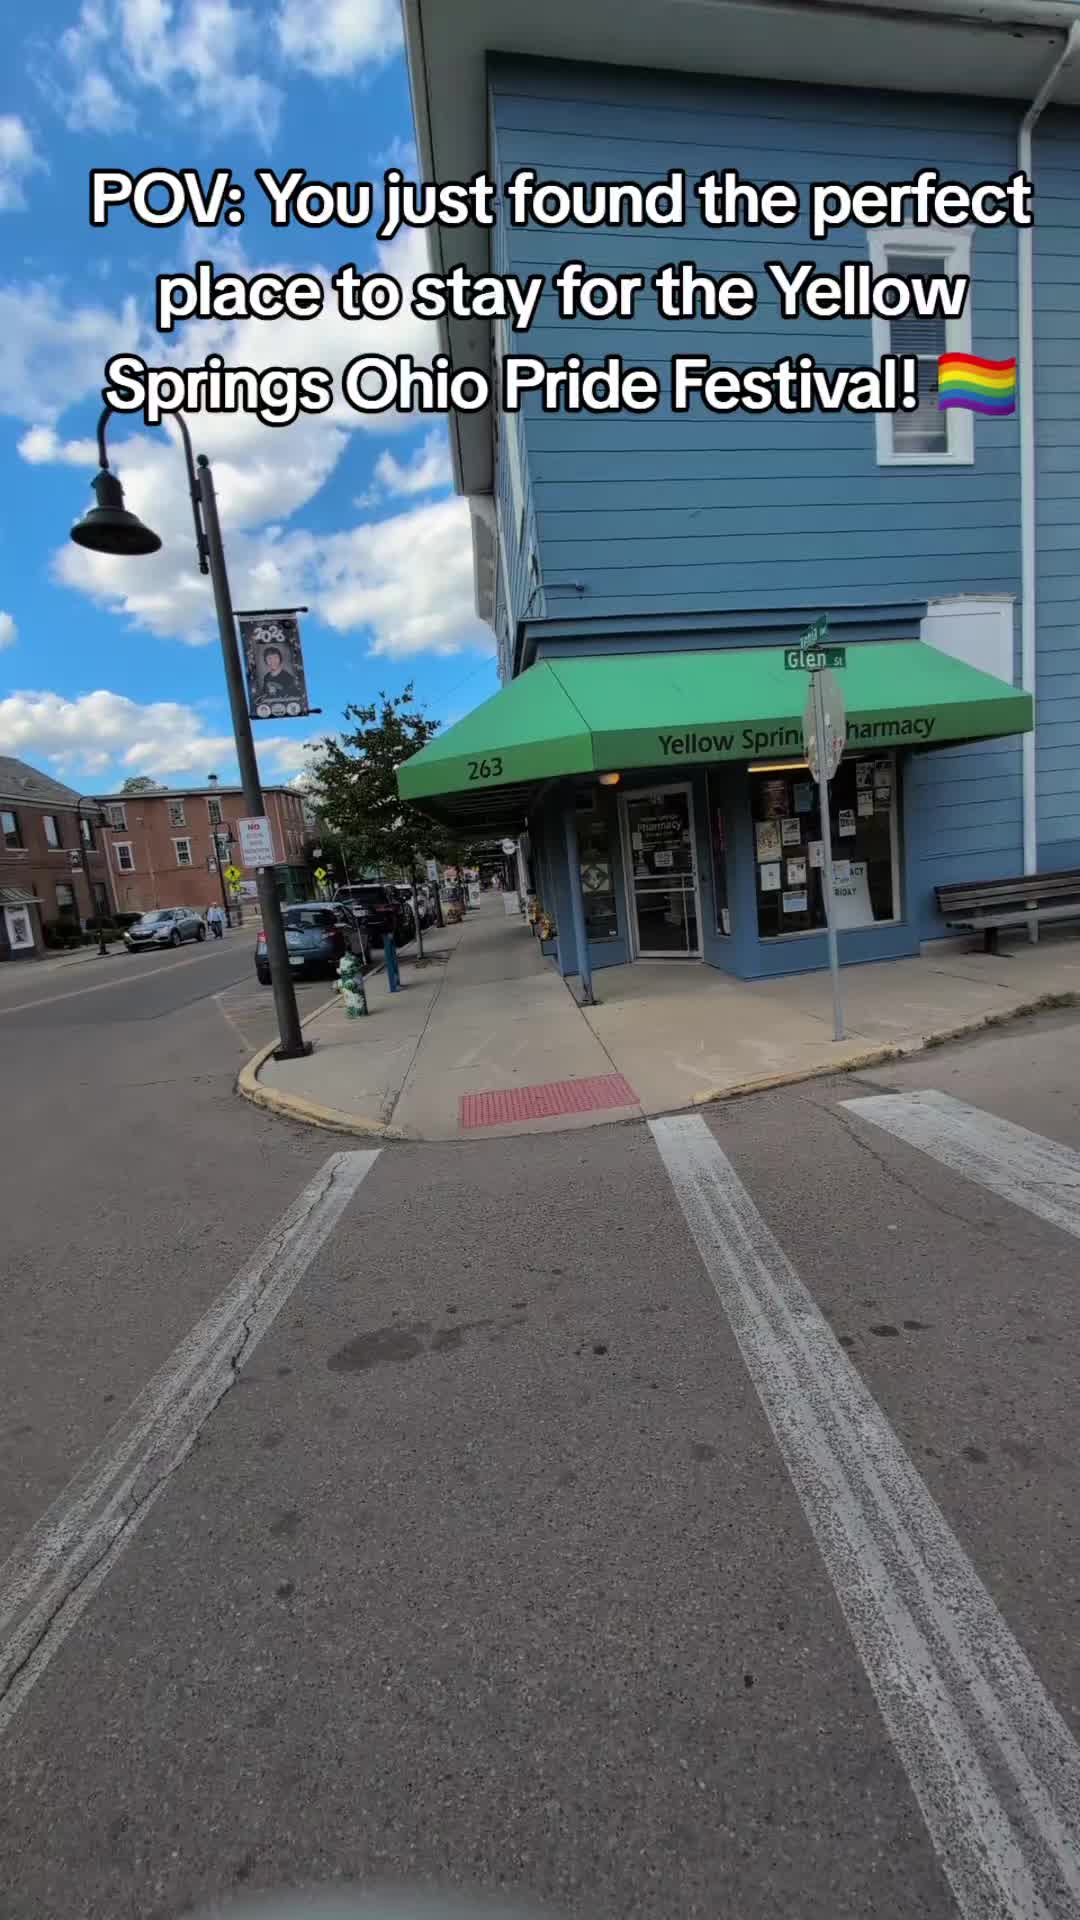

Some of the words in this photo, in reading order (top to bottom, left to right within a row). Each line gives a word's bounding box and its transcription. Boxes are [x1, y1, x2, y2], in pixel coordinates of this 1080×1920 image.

[787, 651, 827, 668] Glen
[833, 656, 844, 666] St
[658, 732, 735, 756] Yellow
[742, 725, 804, 753] Sprin
[845, 717, 936, 739] harmacy
[467, 757, 503, 781] 263
[247, 823, 261, 831] NO
[833, 887, 857, 897] RIDAY
